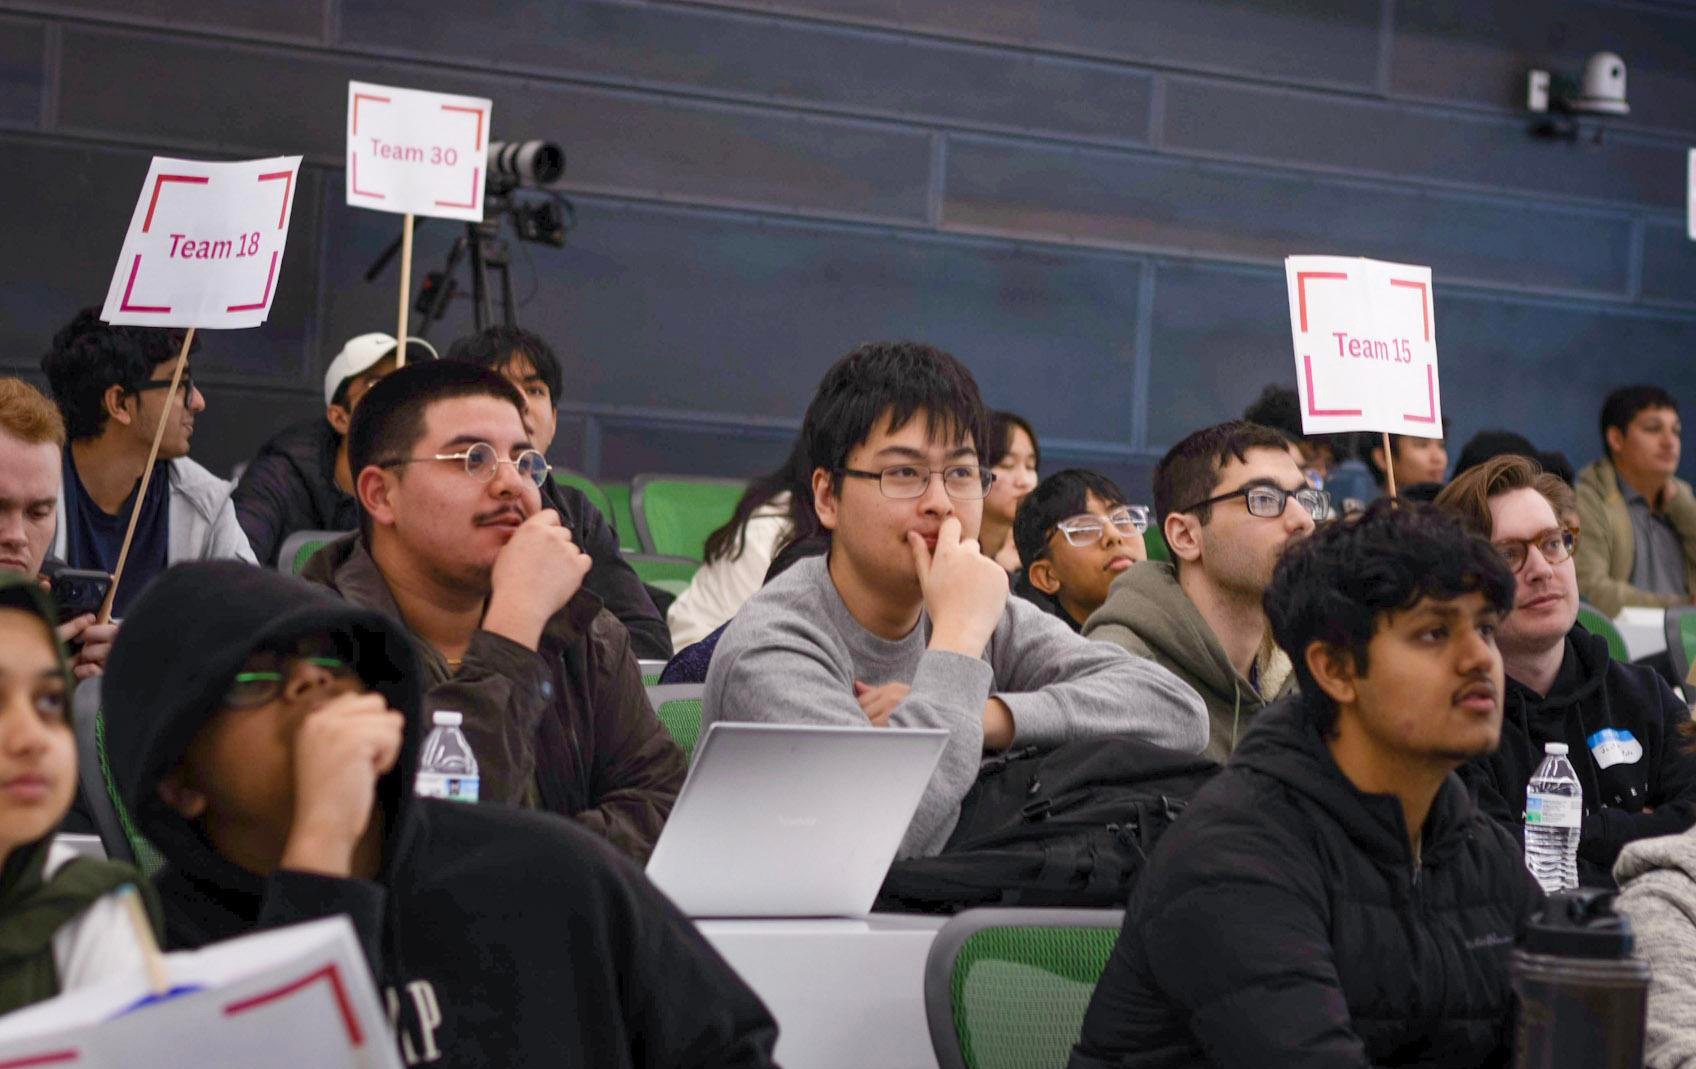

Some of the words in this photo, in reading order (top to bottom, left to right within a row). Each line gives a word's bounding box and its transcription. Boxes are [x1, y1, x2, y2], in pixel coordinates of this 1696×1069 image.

[371, 137, 423, 162] Team
[431, 146, 457, 166] 30
[169, 233, 232, 259] Team
[236, 231, 260, 258] 18
[1333, 332, 1389, 361] Team
[1394, 338, 1411, 364] 15
